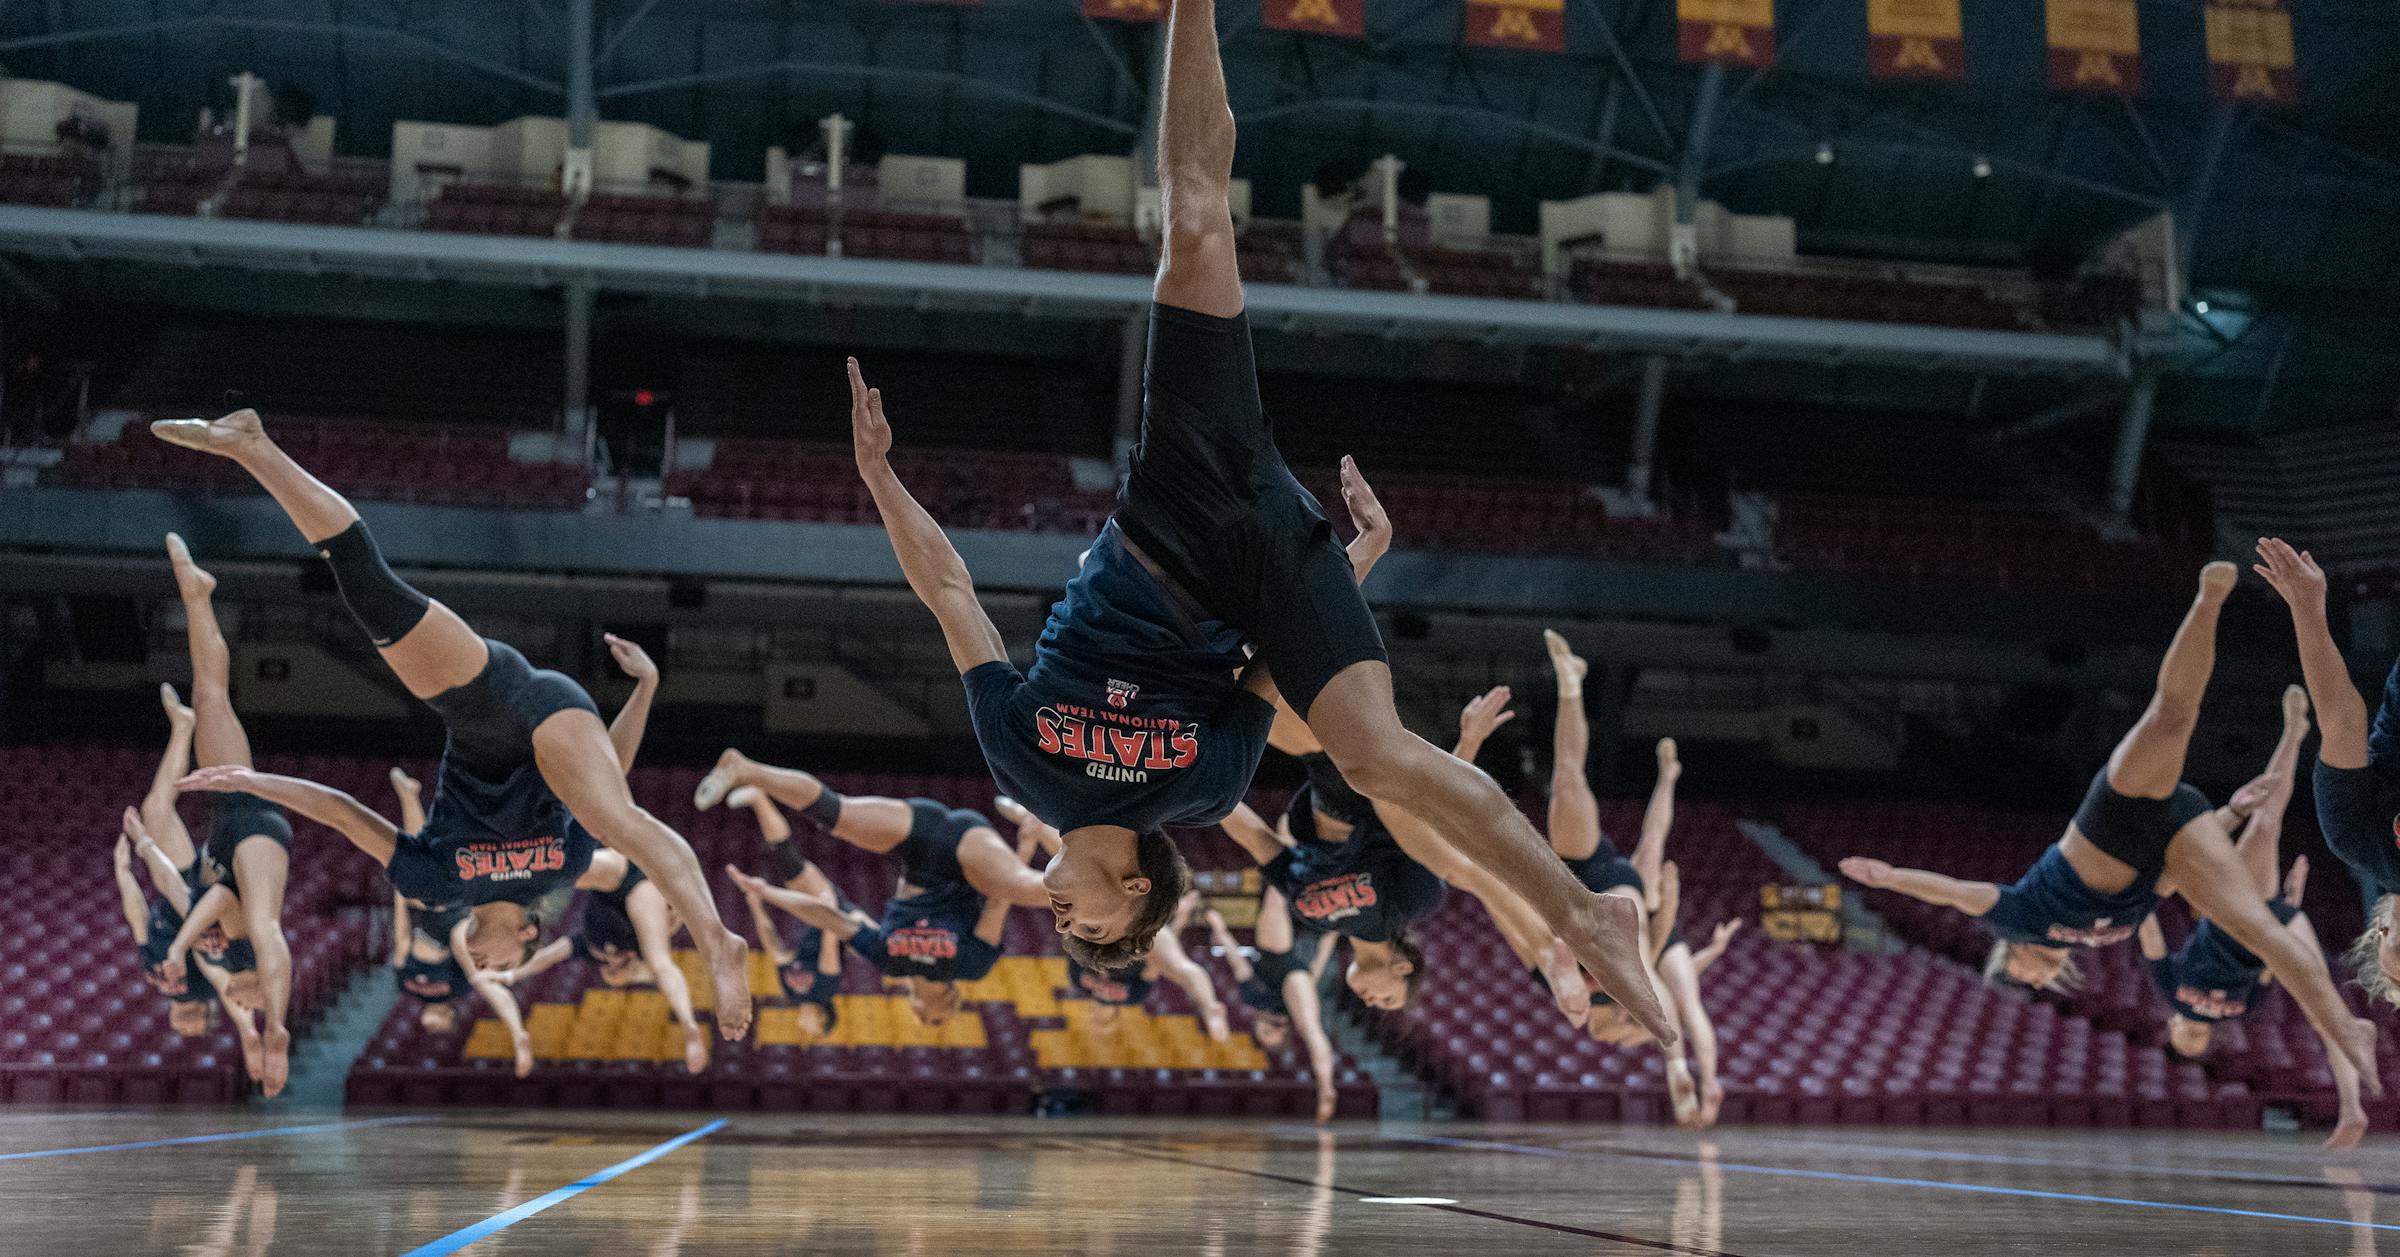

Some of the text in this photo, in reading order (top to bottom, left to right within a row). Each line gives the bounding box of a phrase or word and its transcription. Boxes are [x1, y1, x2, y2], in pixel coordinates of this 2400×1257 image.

[1106, 677, 1141, 693] CHEER
[1055, 702, 1181, 731] NATIONAL TEAM
[1035, 706, 1199, 770] STATES
[1085, 761, 1148, 784] UNITED
[455, 838, 565, 880] STATES
